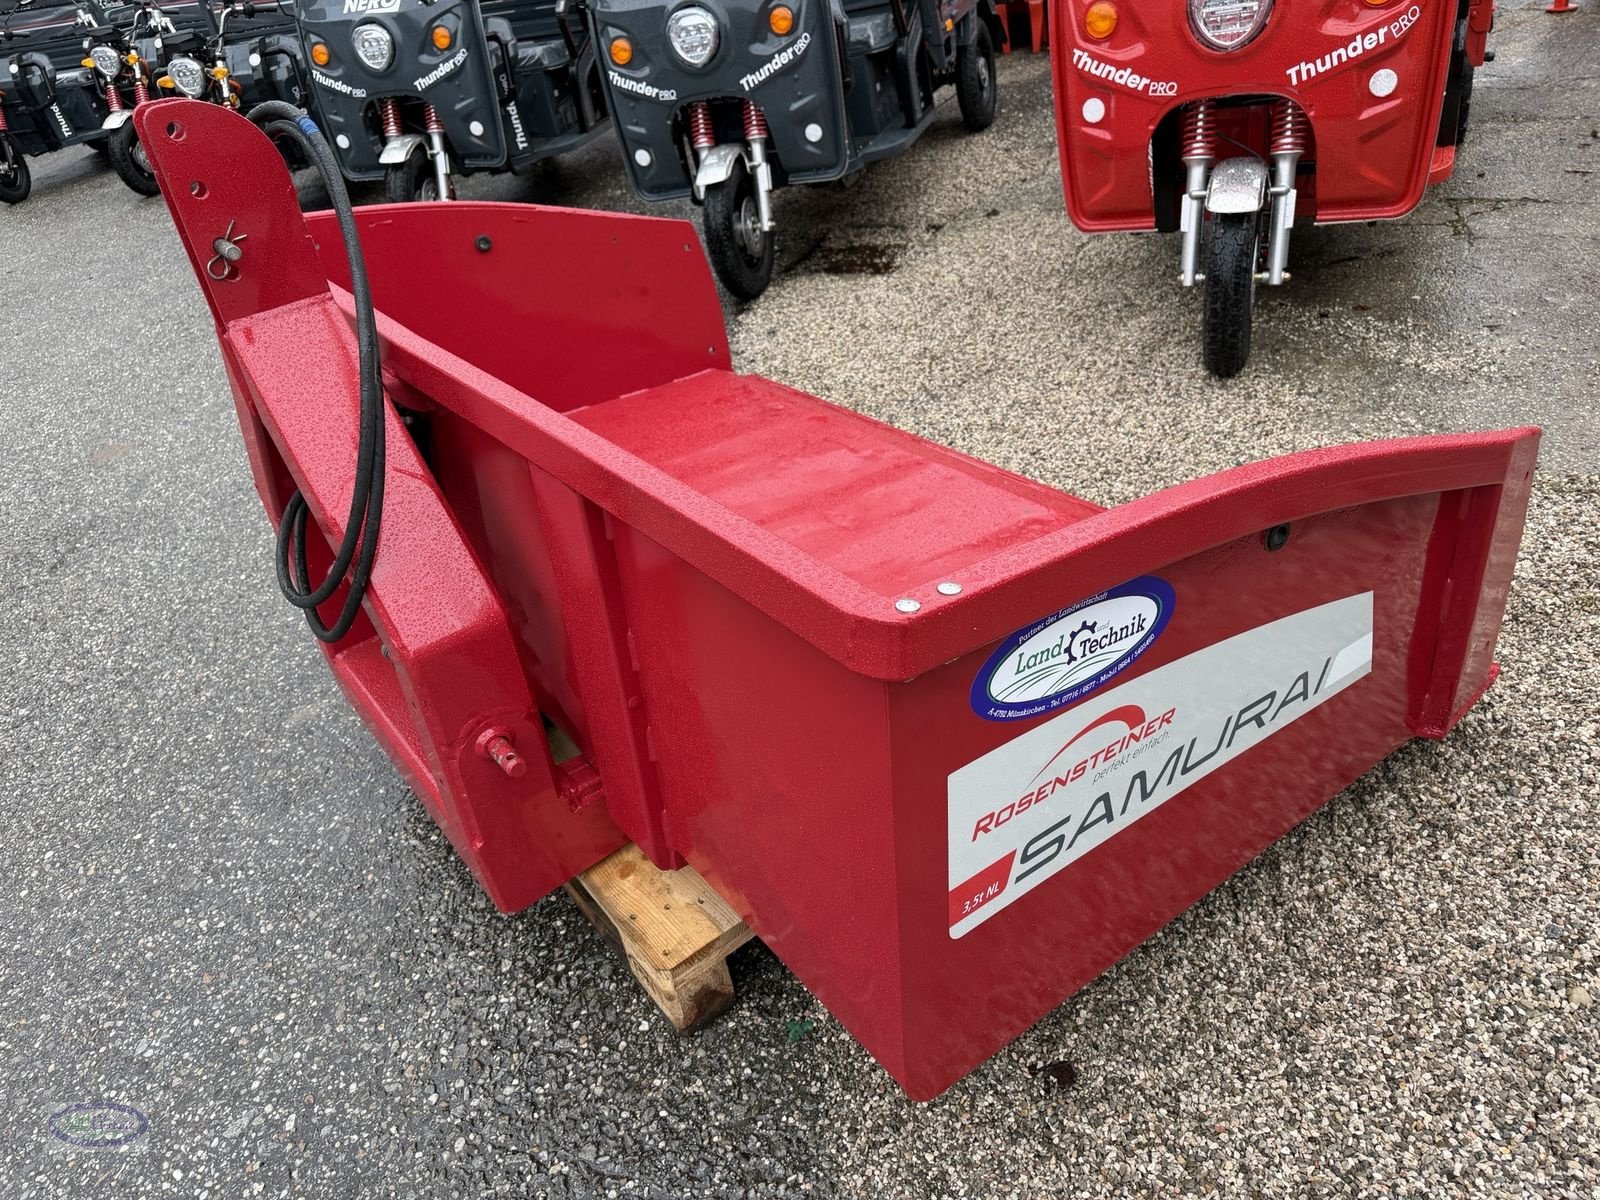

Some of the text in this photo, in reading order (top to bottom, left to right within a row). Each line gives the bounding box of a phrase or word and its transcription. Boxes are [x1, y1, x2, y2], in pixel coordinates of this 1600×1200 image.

[739, 32, 812, 92] Thunder PRO
[1286, 5, 1421, 86] Thunder PRO
[311, 69, 353, 95] Thunder
[352, 88, 367, 98] PRO
[413, 48, 469, 92] Thunder PRO
[608, 70, 678, 101] Thunder PRO
[1072, 48, 1178, 96] Thunder PRO
[1018, 592, 1108, 645] Partner der Landwirtschaft
[1079, 613, 1147, 659] Technik
[1096, 620, 1111, 632] und
[1014, 634, 1065, 675] Land
[1050, 698, 1061, 708] Tel.
[1099, 666, 1117, 683] Mobil
[971, 707, 1176, 842] ROSENSTEINER
[1015, 656, 1332, 885] SAMURAI
[1092, 752, 1131, 786] perfekt
[962, 881, 1000, 914] 3,5t NL
